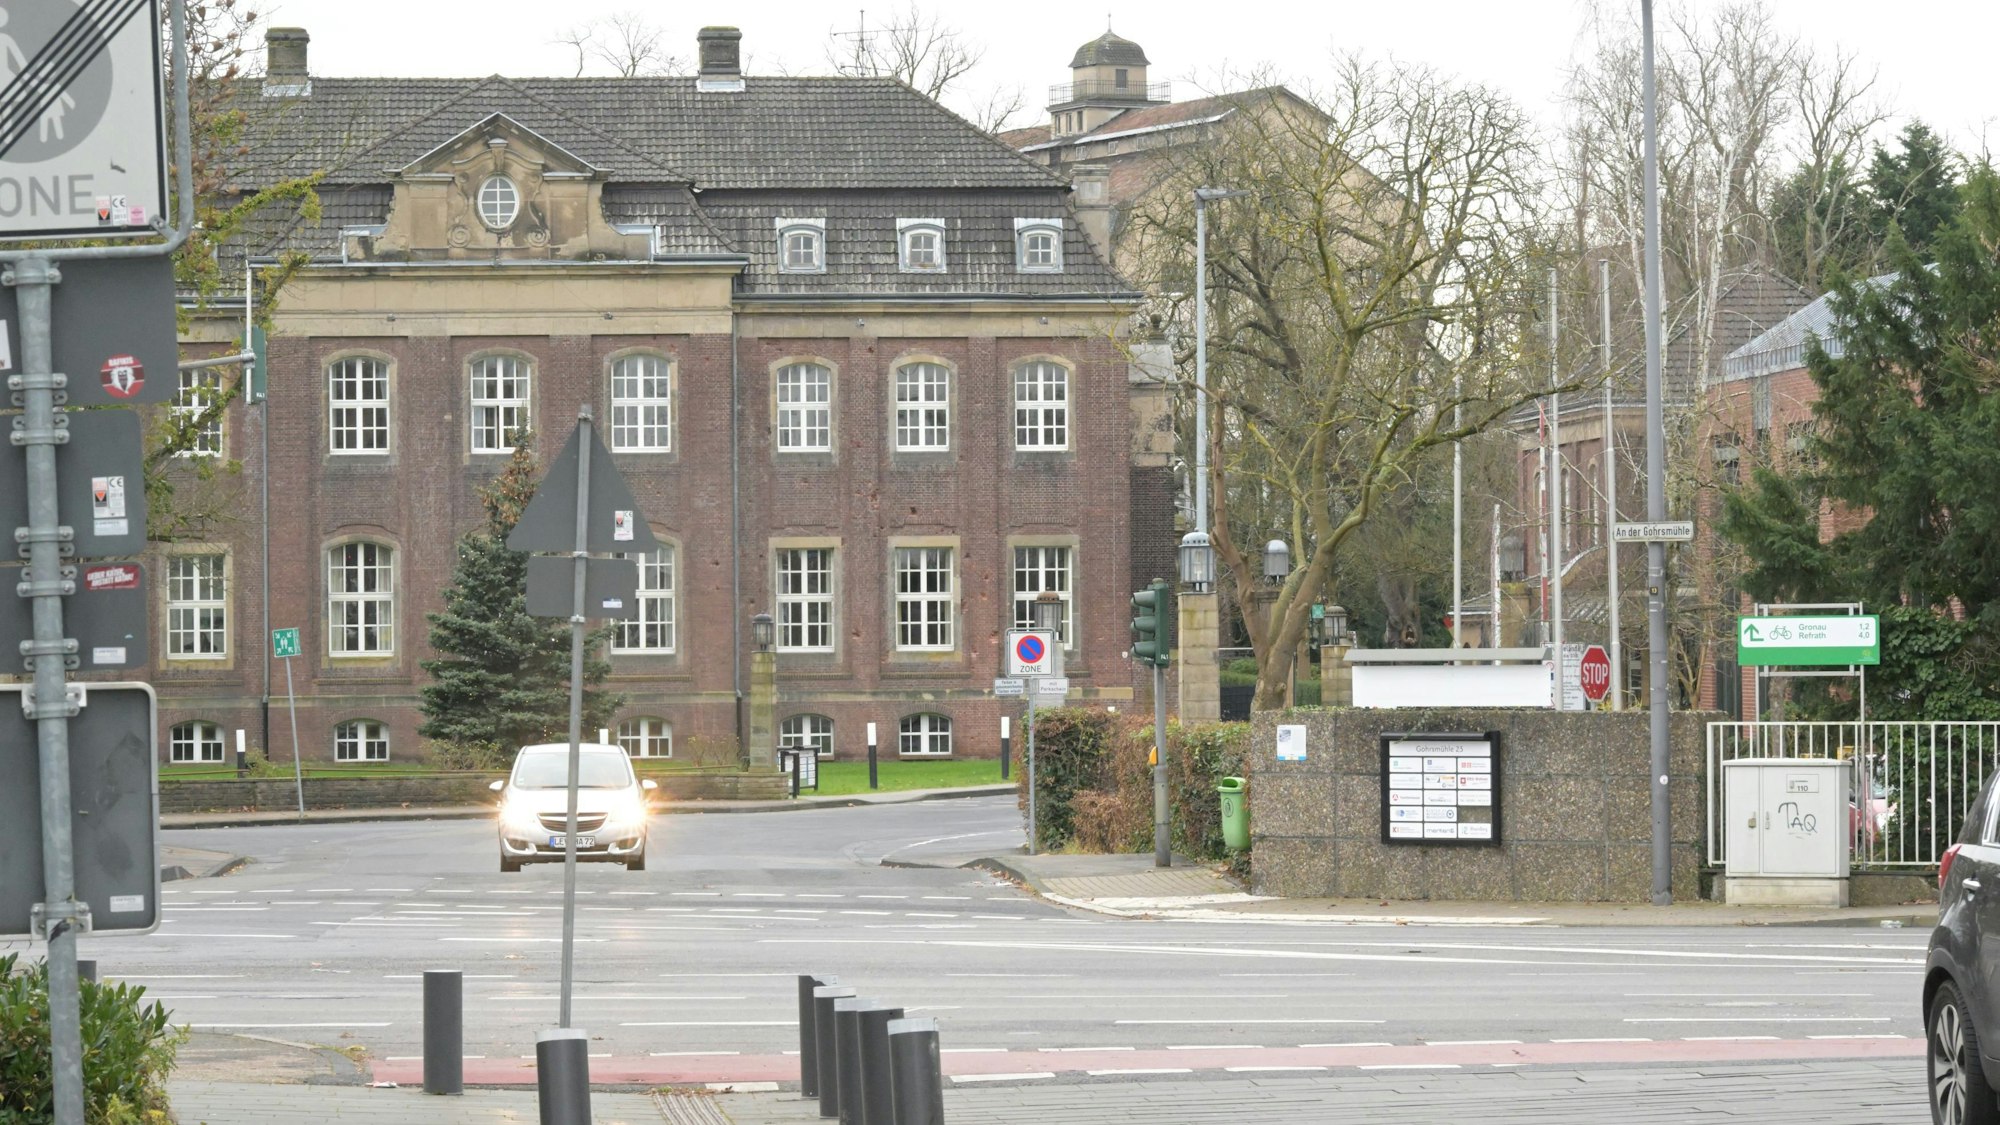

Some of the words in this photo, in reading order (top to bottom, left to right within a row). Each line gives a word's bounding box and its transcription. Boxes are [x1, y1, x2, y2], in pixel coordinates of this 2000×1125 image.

[1616, 527, 1626, 537] An
[1628, 526, 1641, 537] der
[1643, 525, 1690, 537] Gohrsmühle
[1798, 623, 1827, 631] Gronau
[1859, 623, 1870, 631] 1,2
[1858, 631, 1870, 639] 4,0
[1020, 665, 1042, 673] ZONE
[1583, 663, 1608, 684] STOP
[1415, 745, 1454, 753] Gohrsmühle
